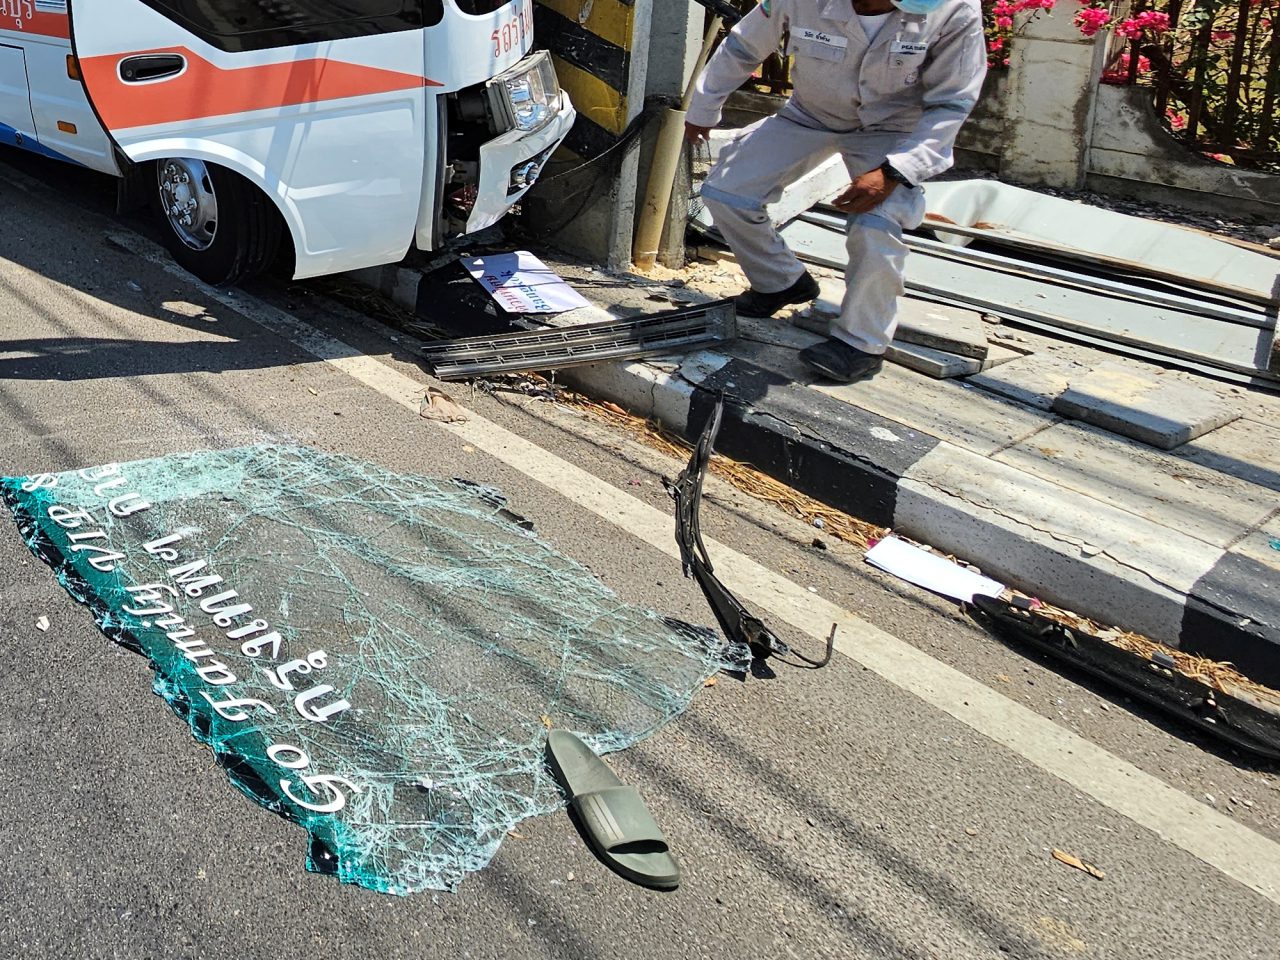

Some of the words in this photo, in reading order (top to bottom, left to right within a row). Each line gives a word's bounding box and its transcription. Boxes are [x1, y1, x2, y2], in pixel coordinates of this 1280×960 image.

[500, 269, 553, 312] Bangkok
[48, 504, 126, 572] VIP
[122, 582, 277, 722] Family
[141, 532, 352, 723] กรุงเทพฯ
[265, 743, 363, 813] Go
